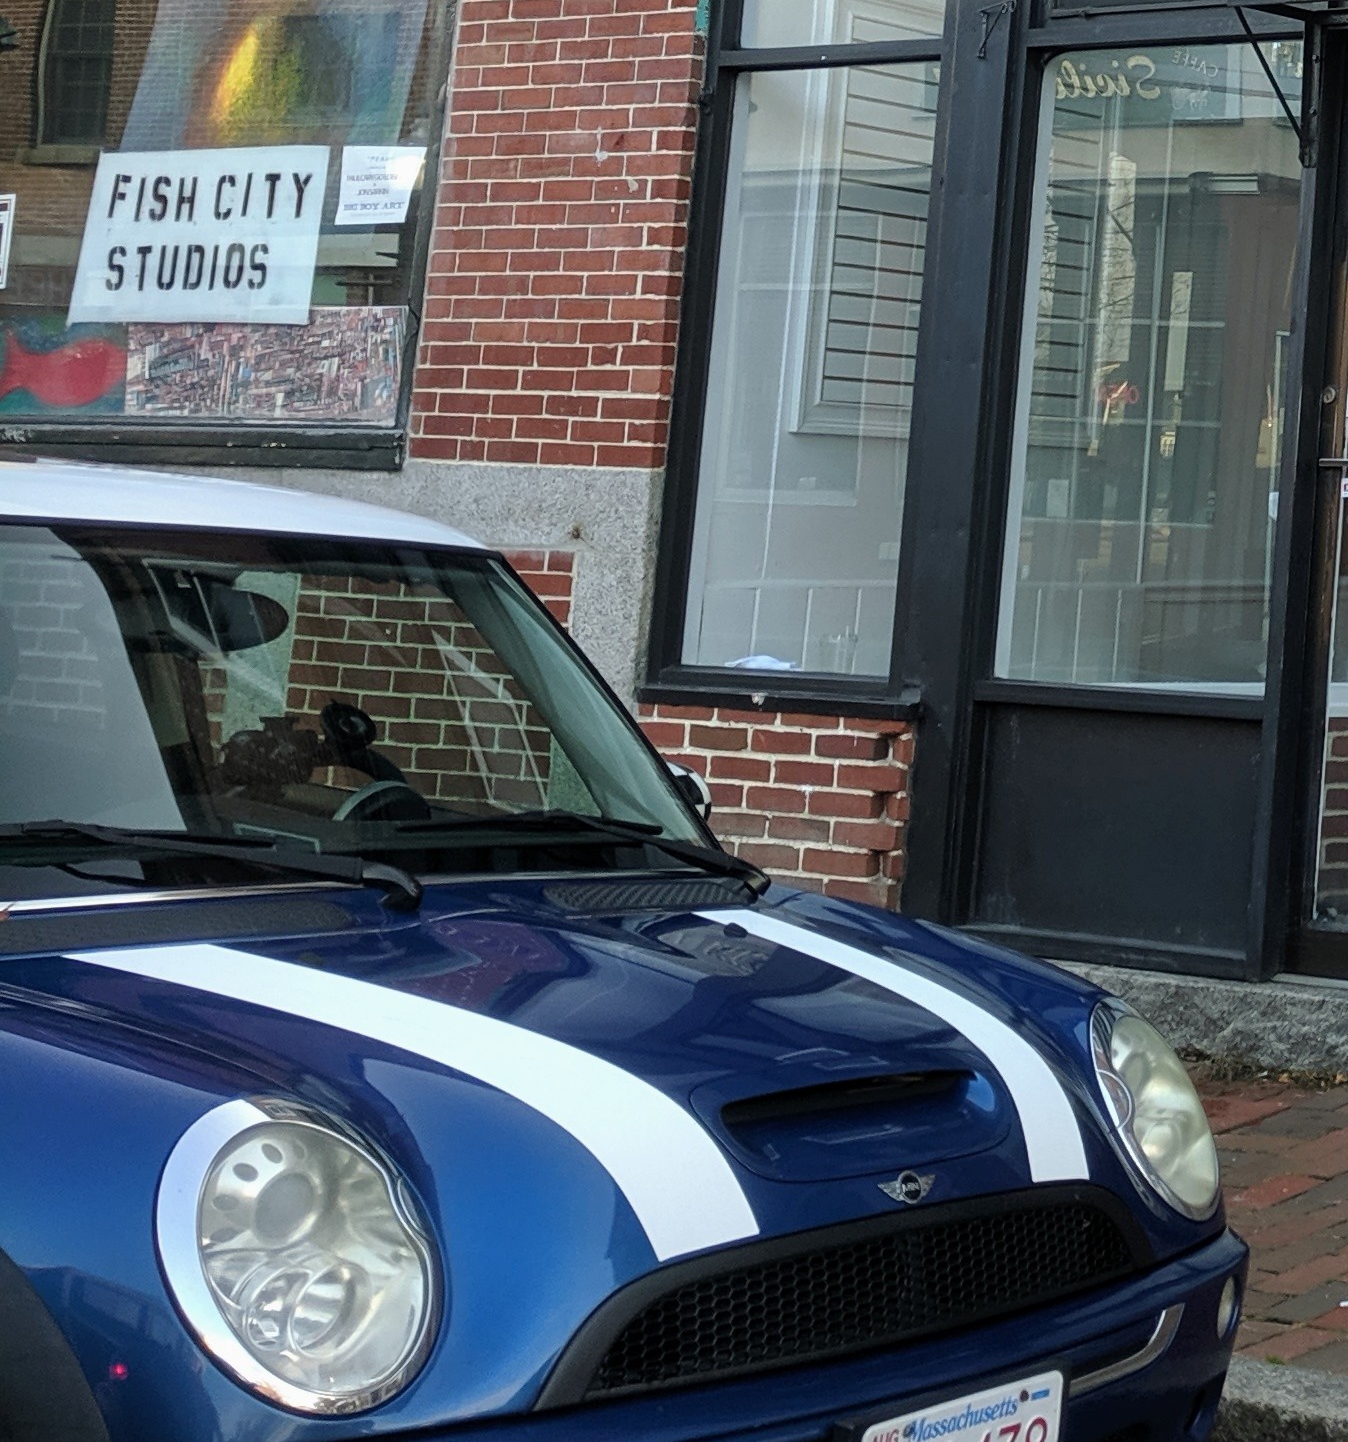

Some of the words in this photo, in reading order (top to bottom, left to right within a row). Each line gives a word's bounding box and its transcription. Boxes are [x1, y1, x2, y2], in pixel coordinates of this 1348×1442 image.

[106, 172, 198, 222] FISH
[213, 171, 313, 221] CITY
[105, 243, 270, 292] STUDIOS
[903, 1396, 1018, 1442] Massachusetts
